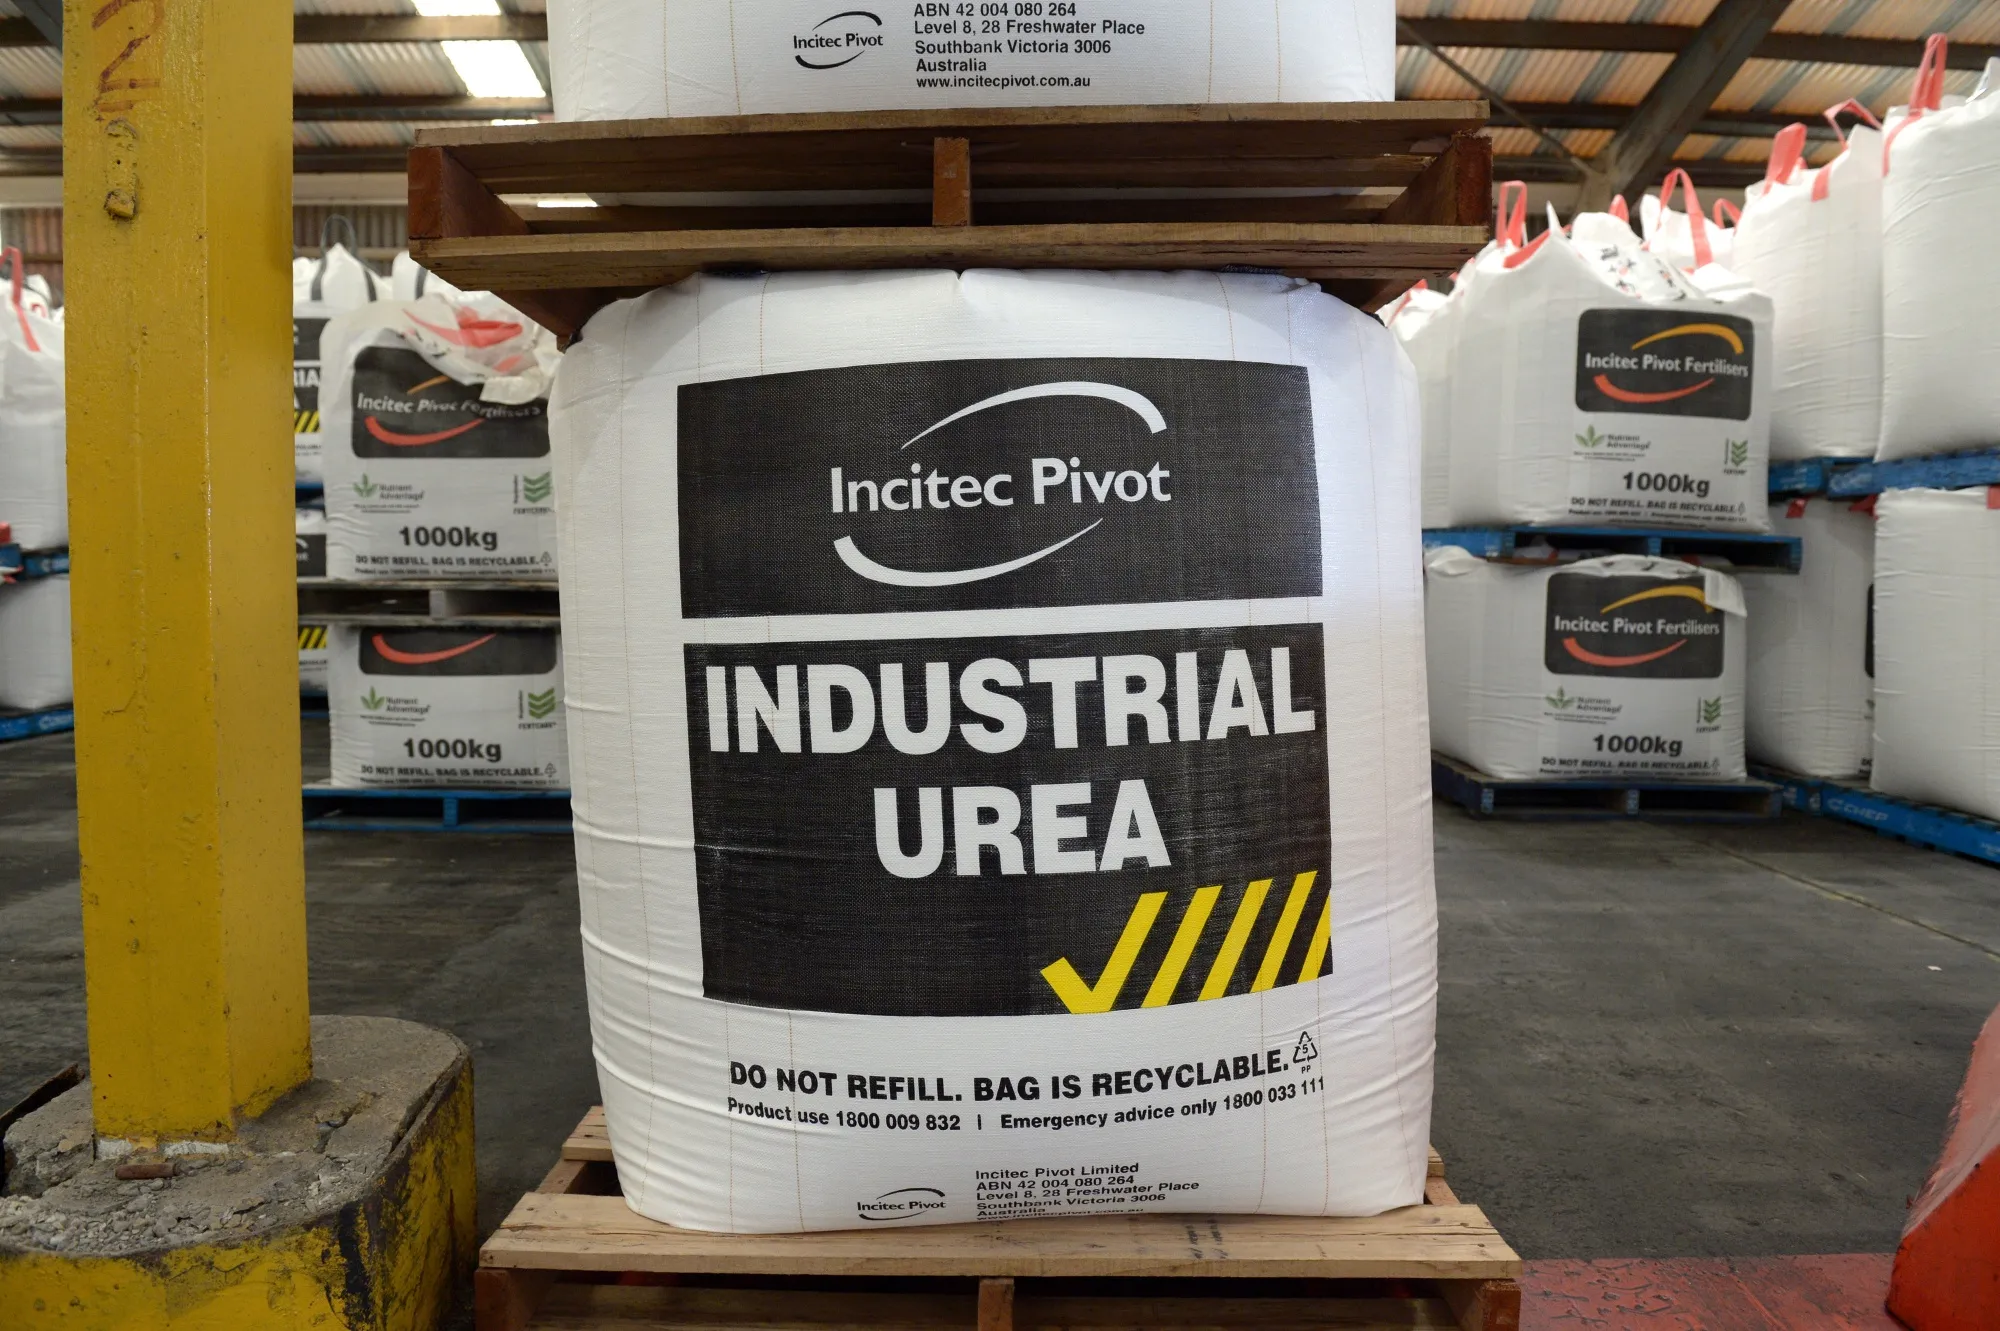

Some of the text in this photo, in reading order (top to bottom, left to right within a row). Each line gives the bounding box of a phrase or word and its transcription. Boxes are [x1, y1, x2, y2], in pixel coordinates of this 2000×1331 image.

[914, 3, 1076, 17] ABN 42 004 080 264
[914, 19, 1145, 36] Level 8, 28 Freshwater Place
[793, 32, 884, 50] Incitec Pivot
[915, 39, 1112, 55] Southbank Victoria 3006
[916, 58, 987, 72] Australia
[916, 74, 1091, 89] www.incitecpivot.com.au
[1585, 352, 1749, 378] Incitec Pivot Fertilisers
[357, 392, 413, 413] Incitec
[831, 456, 1171, 515] Incitec Pivot
[1622, 471, 1711, 498] 1000kg
[399, 526, 498, 551] 1000kg
[1554, 614, 1720, 636] Incitec Pivot Fertilisers
[706, 646, 1316, 756] INDUSTRIAL
[404, 738, 502, 763] 1000kg
[1593, 733, 1683, 758] 1000kg
[873, 778, 1171, 879] UREA
[730, 1049, 1289, 1101] DO NOT REFILL. BAG IS RECYCLABLE.
[1301, 1064, 1312, 1074] PP
[727, 1096, 793, 1121] Product
[797, 1110, 829, 1125] use
[835, 1110, 880, 1129] 1800
[886, 1113, 920, 1130] 009
[925, 1114, 961, 1130] 832
[1000, 1111, 1108, 1130] Emergency
[1114, 1105, 1175, 1123] advice
[1181, 1097, 1217, 1116] only
[1223, 1089, 1263, 1110] 1800
[1267, 1082, 1297, 1103] 033
[1301, 1075, 1325, 1096] 111
[976, 1163, 1139, 1180] Incitec Pivot Limited
[976, 1175, 1135, 1191] ABN 42 004 080 264
[976, 1182, 1200, 1201] Level 8, 28 Freshwater Place
[857, 1200, 947, 1212] Incitec Pivot
[977, 1193, 1166, 1211] Southbank Victoria 3006
[977, 1207, 1046, 1217] Australia
